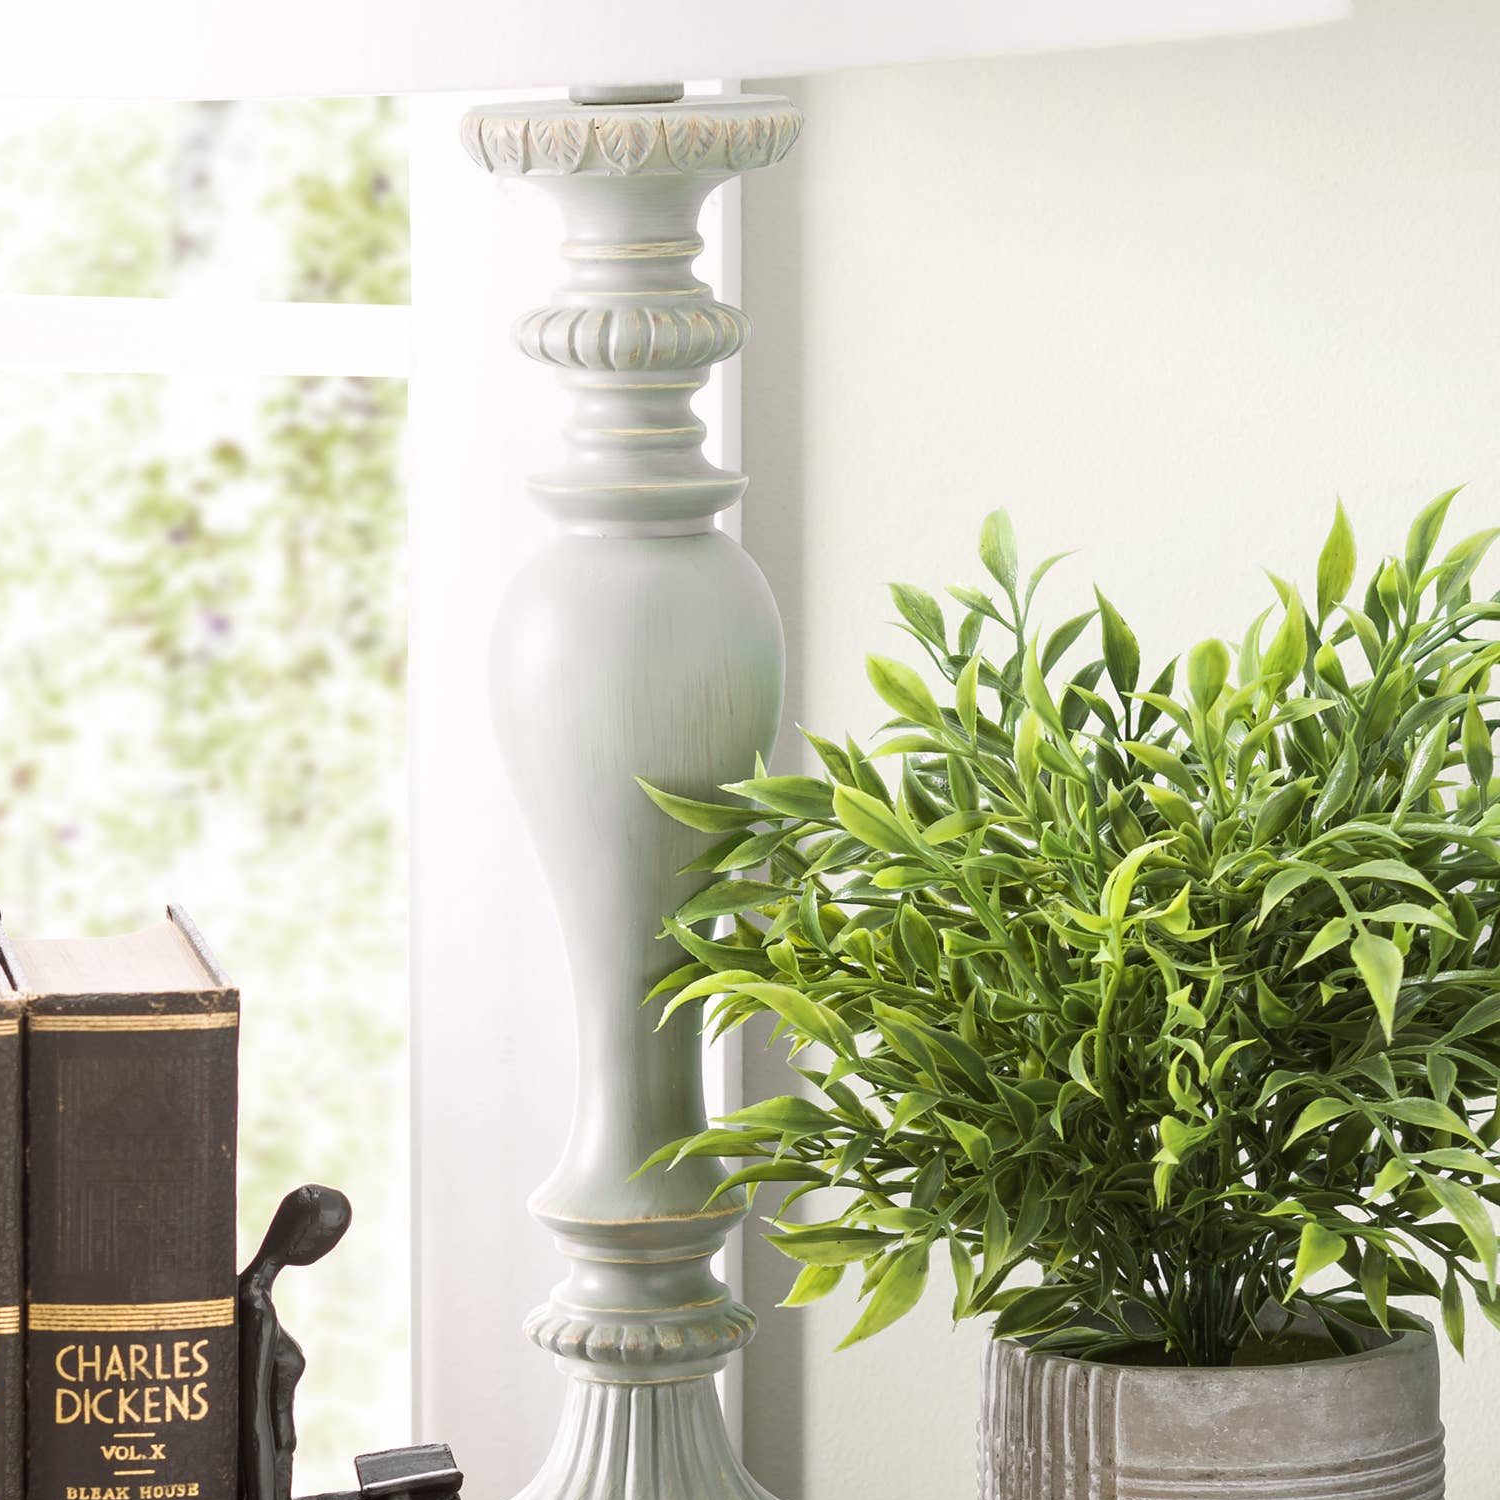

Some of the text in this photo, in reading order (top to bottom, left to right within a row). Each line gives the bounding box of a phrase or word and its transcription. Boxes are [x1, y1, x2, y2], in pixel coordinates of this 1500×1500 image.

[55, 1339, 209, 1382] CHARLES
[55, 1382, 209, 1424] DICKENS
[100, 1444, 166, 1461] VOL. X
[66, 1483, 200, 1500] BLEAK HOUSE
